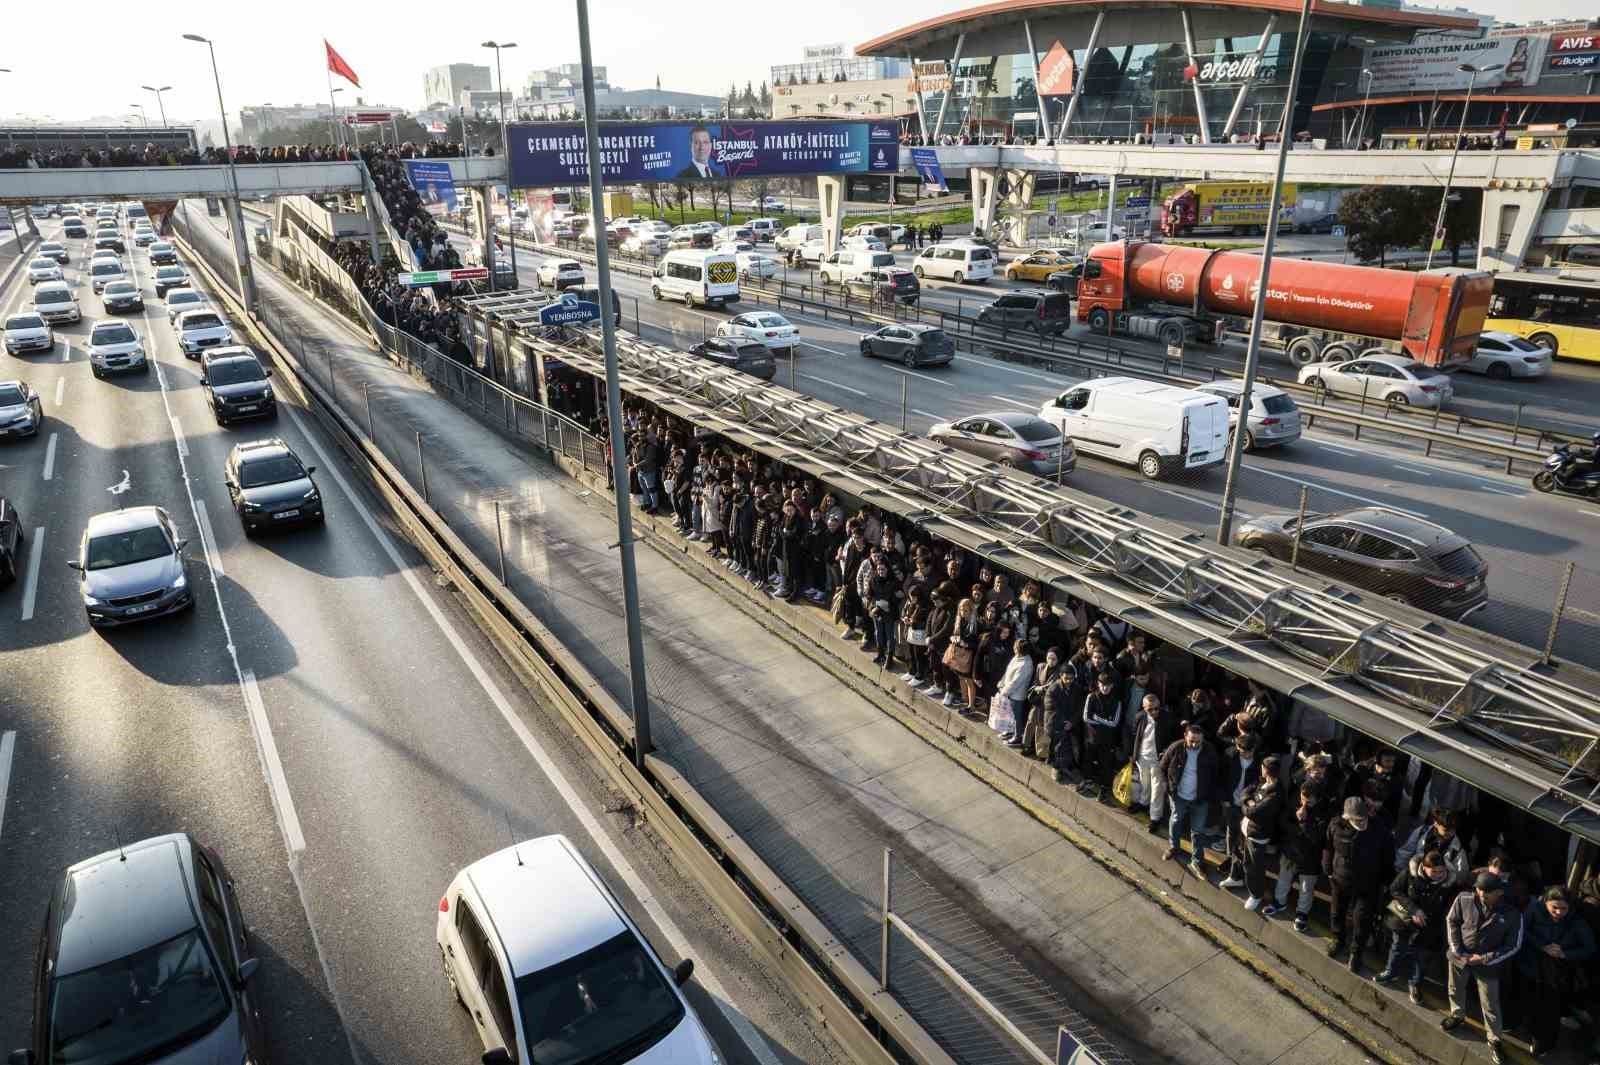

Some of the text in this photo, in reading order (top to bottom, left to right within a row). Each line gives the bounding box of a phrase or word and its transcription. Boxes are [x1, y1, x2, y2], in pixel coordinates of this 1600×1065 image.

[1560, 37, 1593, 49] AVIS
[1562, 56, 1594, 65] Budget
[1200, 56, 1260, 81] arçelik
[712, 138, 758, 150] İSTANBUL
[1317, 294, 1329, 305] İçin
[549, 311, 593, 321] YENİBOSNA
